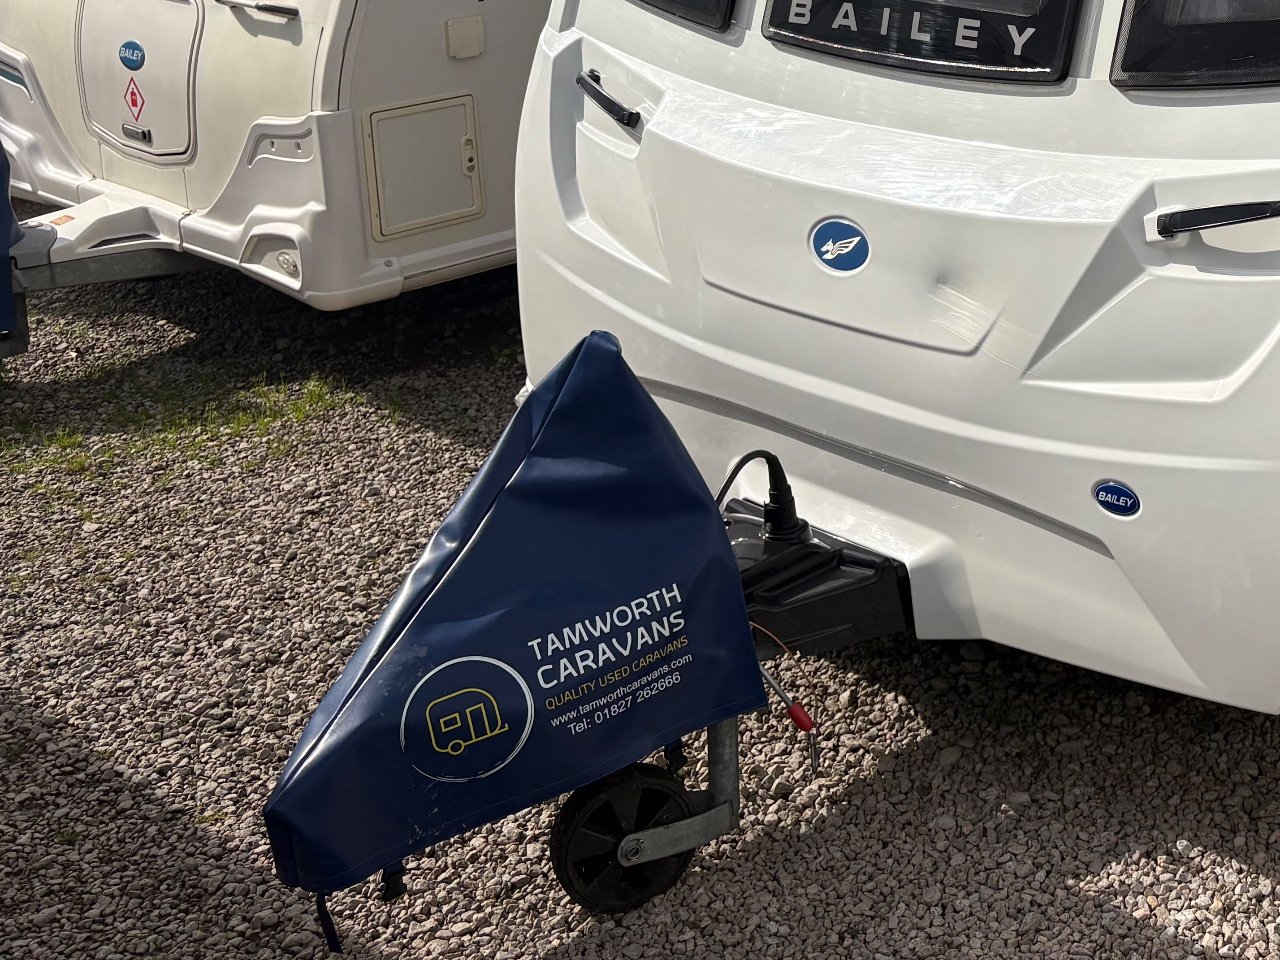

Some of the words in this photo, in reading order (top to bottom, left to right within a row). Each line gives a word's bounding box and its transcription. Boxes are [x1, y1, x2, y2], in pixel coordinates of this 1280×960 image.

[119, 47, 144, 61] BAILEY
[1098, 491, 1134, 507] BAILEY
[527, 583, 682, 661] TAMWORTH
[537, 610, 685, 689] CARAVANS
[545, 679, 596, 710] QUALITY
[599, 665, 630, 687] USED
[632, 635, 689, 672] CARAVANS
[550, 653, 693, 727] www.tamworthcaravans.com
[567, 716, 592, 735] Tel:
[594, 696, 633, 724] 01827
[636, 671, 682, 703] 262666
